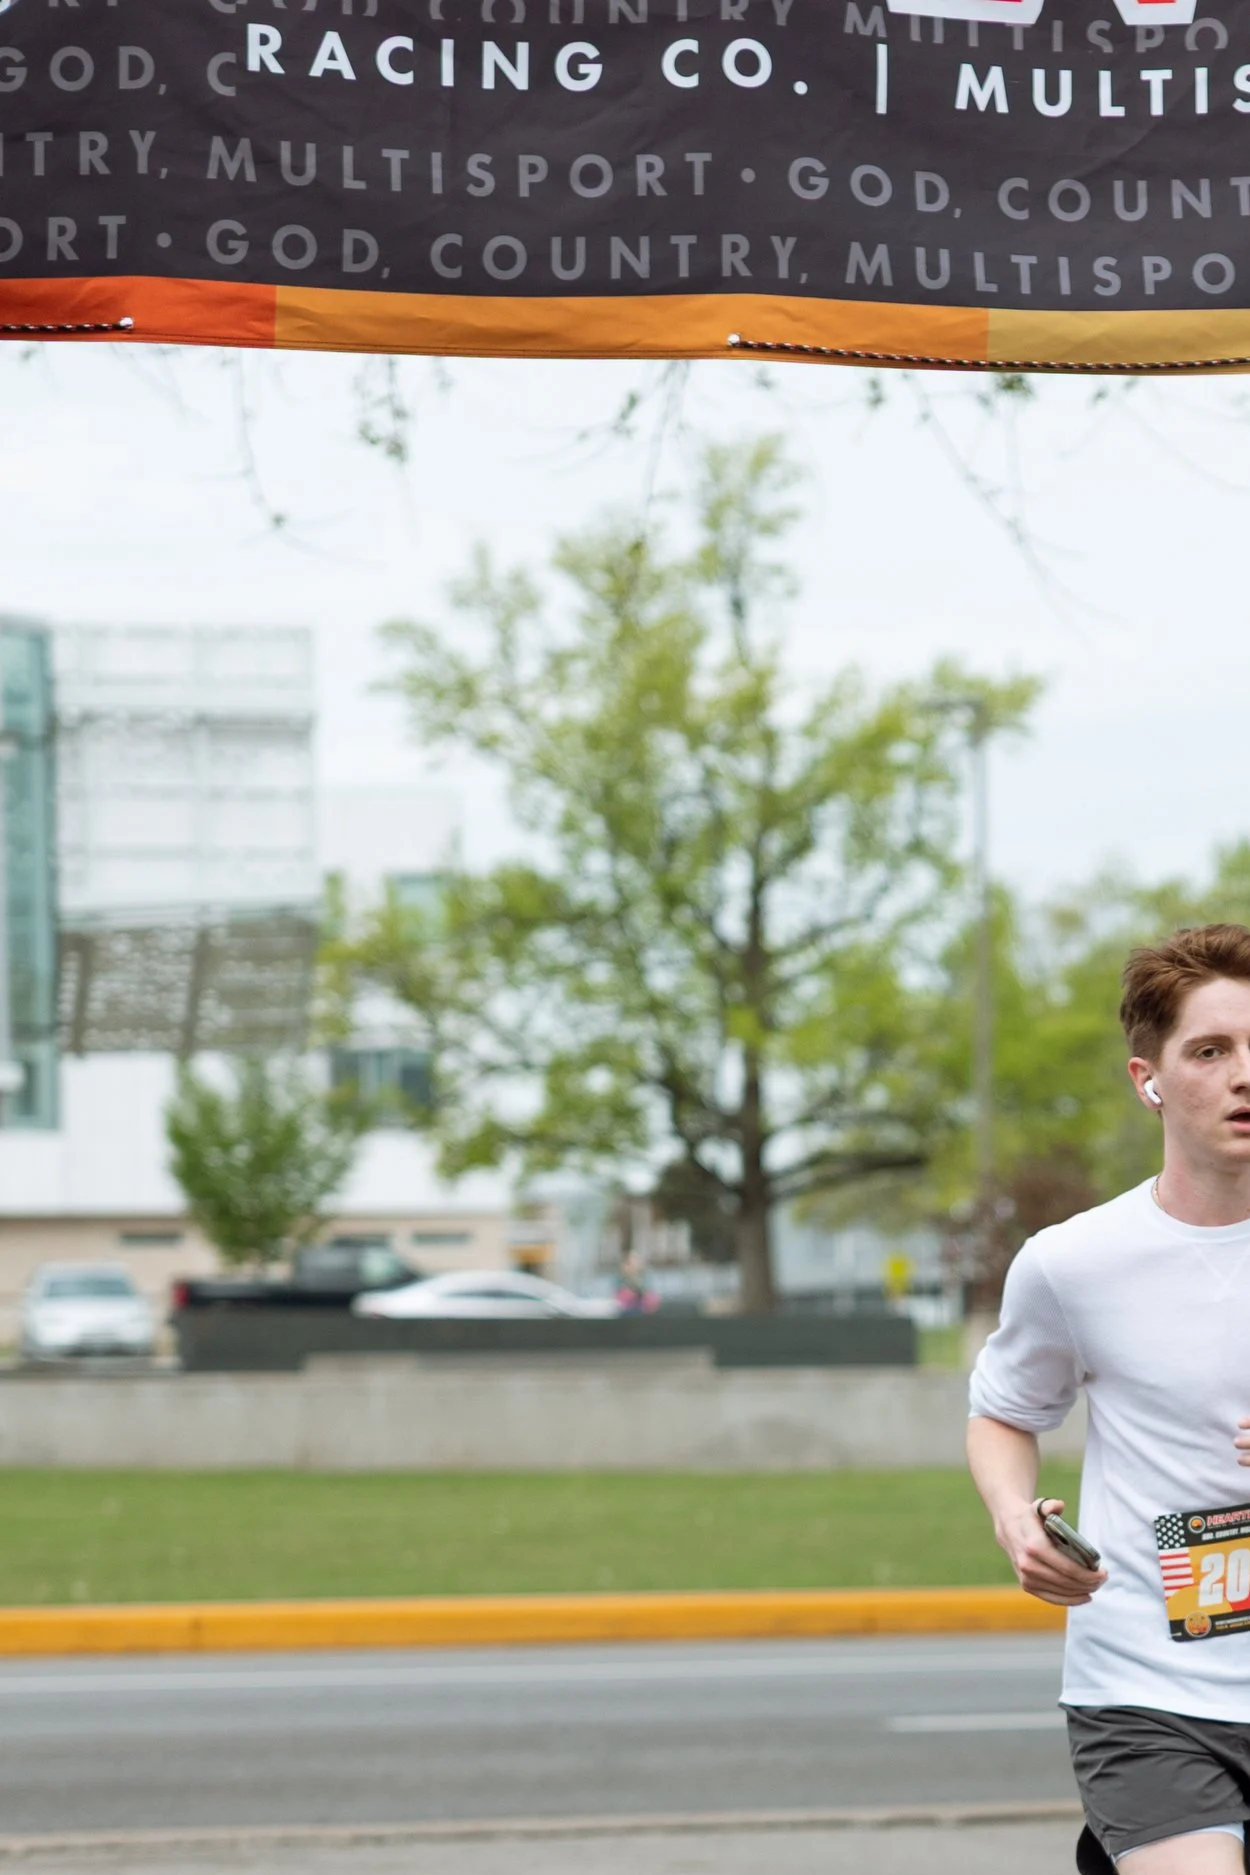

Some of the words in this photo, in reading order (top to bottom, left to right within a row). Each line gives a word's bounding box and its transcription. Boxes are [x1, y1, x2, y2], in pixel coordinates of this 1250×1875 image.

[0, 45, 167, 96] GOD,
[247, 23, 603, 92] RACING
[662, 38, 808, 95] CO.
[0, 129, 168, 180] TRY,
[206, 136, 712, 199] MULTISPORT
[788, 156, 962, 219] GOD,
[206, 219, 390, 279] GOD,
[430, 233, 808, 284] COUNTRY,
